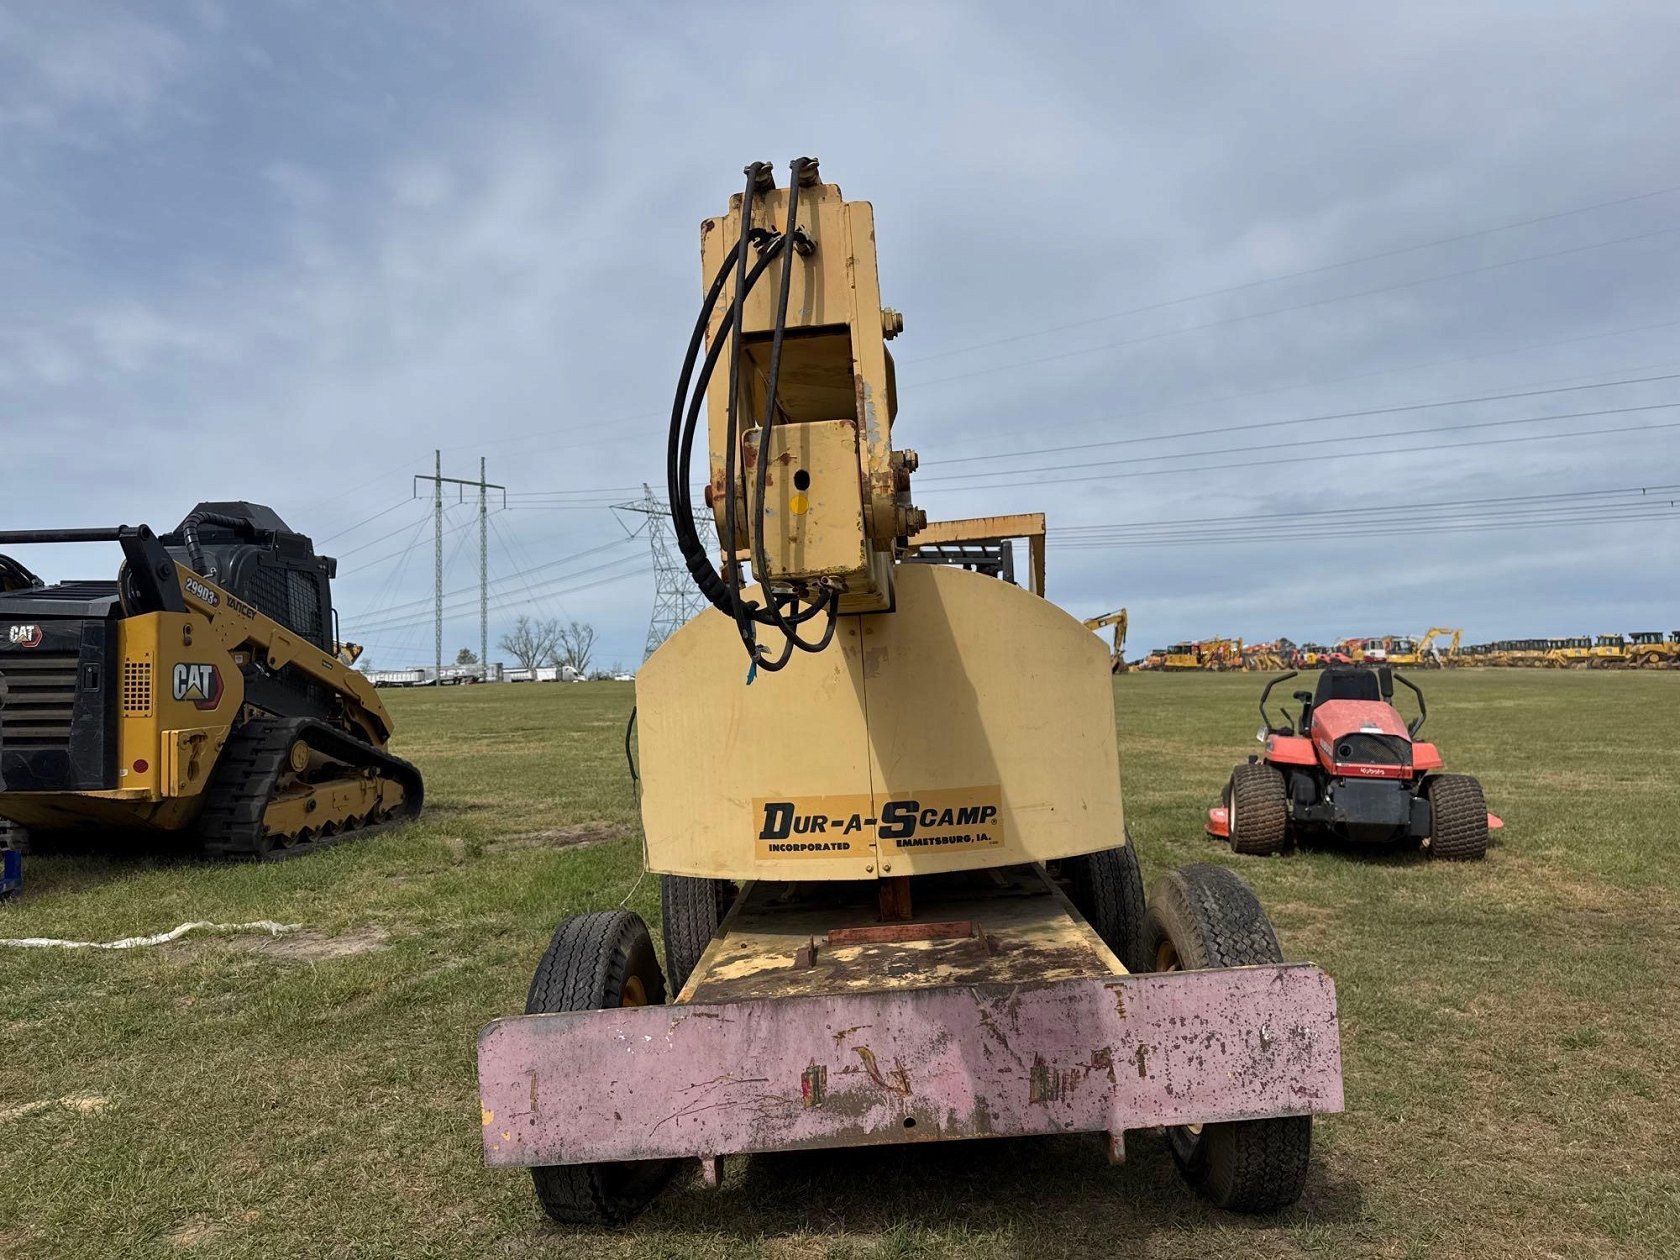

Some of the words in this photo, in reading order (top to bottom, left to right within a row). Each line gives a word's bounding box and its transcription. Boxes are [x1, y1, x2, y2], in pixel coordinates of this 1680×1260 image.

[227, 594, 257, 620] YANCEY
[9, 625, 34, 644] CAT
[173, 664, 212, 699] CAT
[769, 842, 850, 852] INCORPORATED
[896, 834, 974, 848] EMMETSBURG,
[977, 833, 992, 843] IA.
